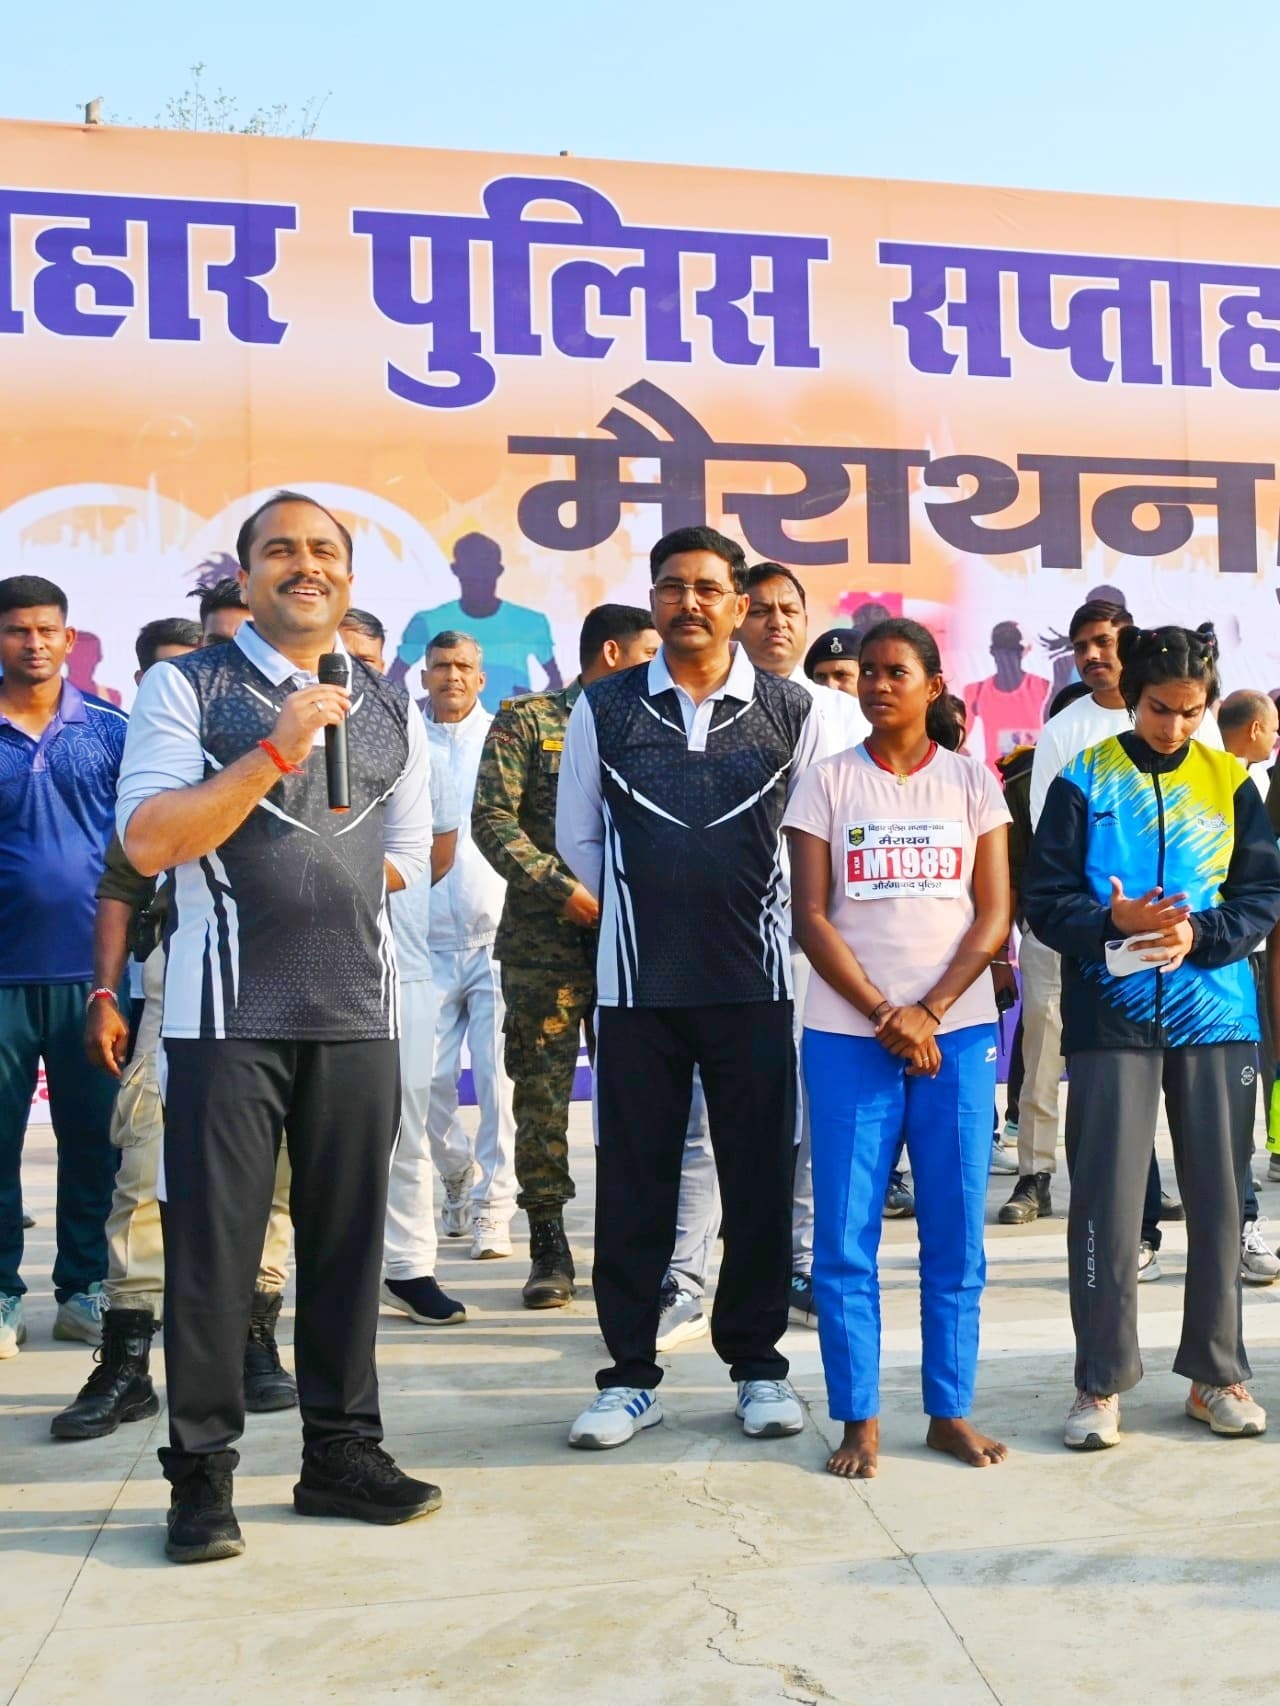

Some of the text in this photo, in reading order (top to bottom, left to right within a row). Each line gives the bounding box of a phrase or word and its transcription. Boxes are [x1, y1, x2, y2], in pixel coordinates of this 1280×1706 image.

[0, 189, 297, 345] हार
[352, 177, 829, 409] पुलिस
[507, 378, 1276, 574] मैराथन
[862, 847, 957, 878] M1989
